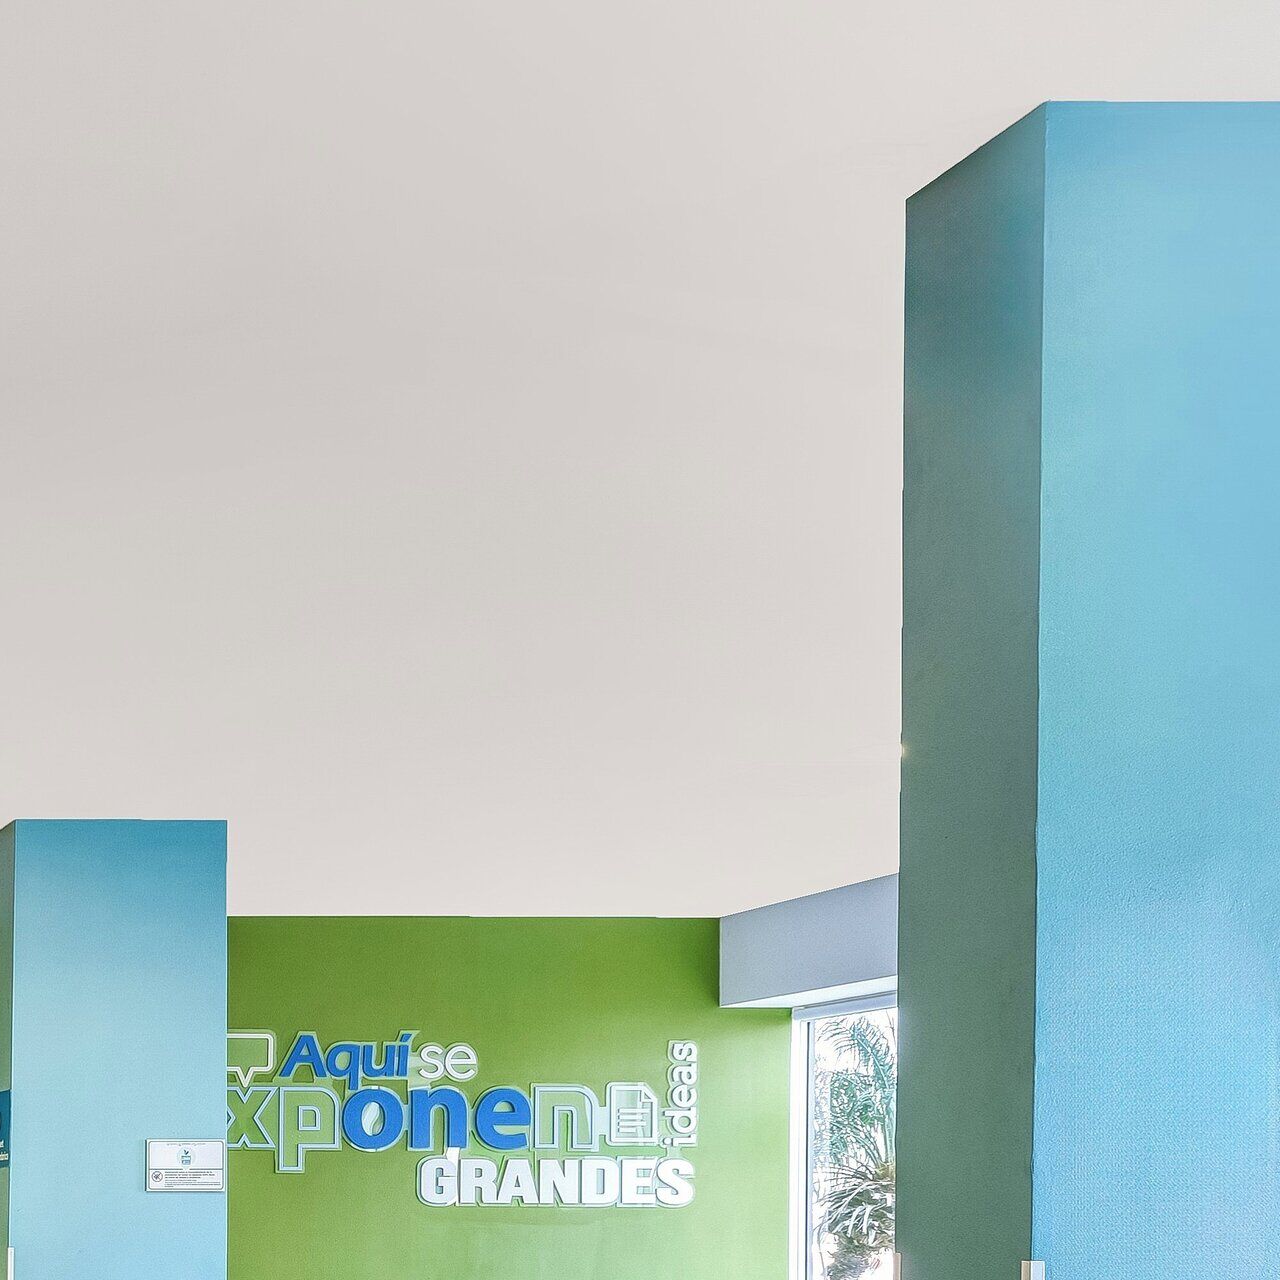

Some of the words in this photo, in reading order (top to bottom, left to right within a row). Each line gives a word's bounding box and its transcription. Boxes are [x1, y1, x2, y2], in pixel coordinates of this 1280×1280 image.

[279, 1033, 413, 1090] Aquí
[418, 1045, 478, 1080] se
[661, 1040, 698, 1147] ideas
[227, 1085, 595, 1172] xponen
[420, 1157, 694, 1206] GRANDES
